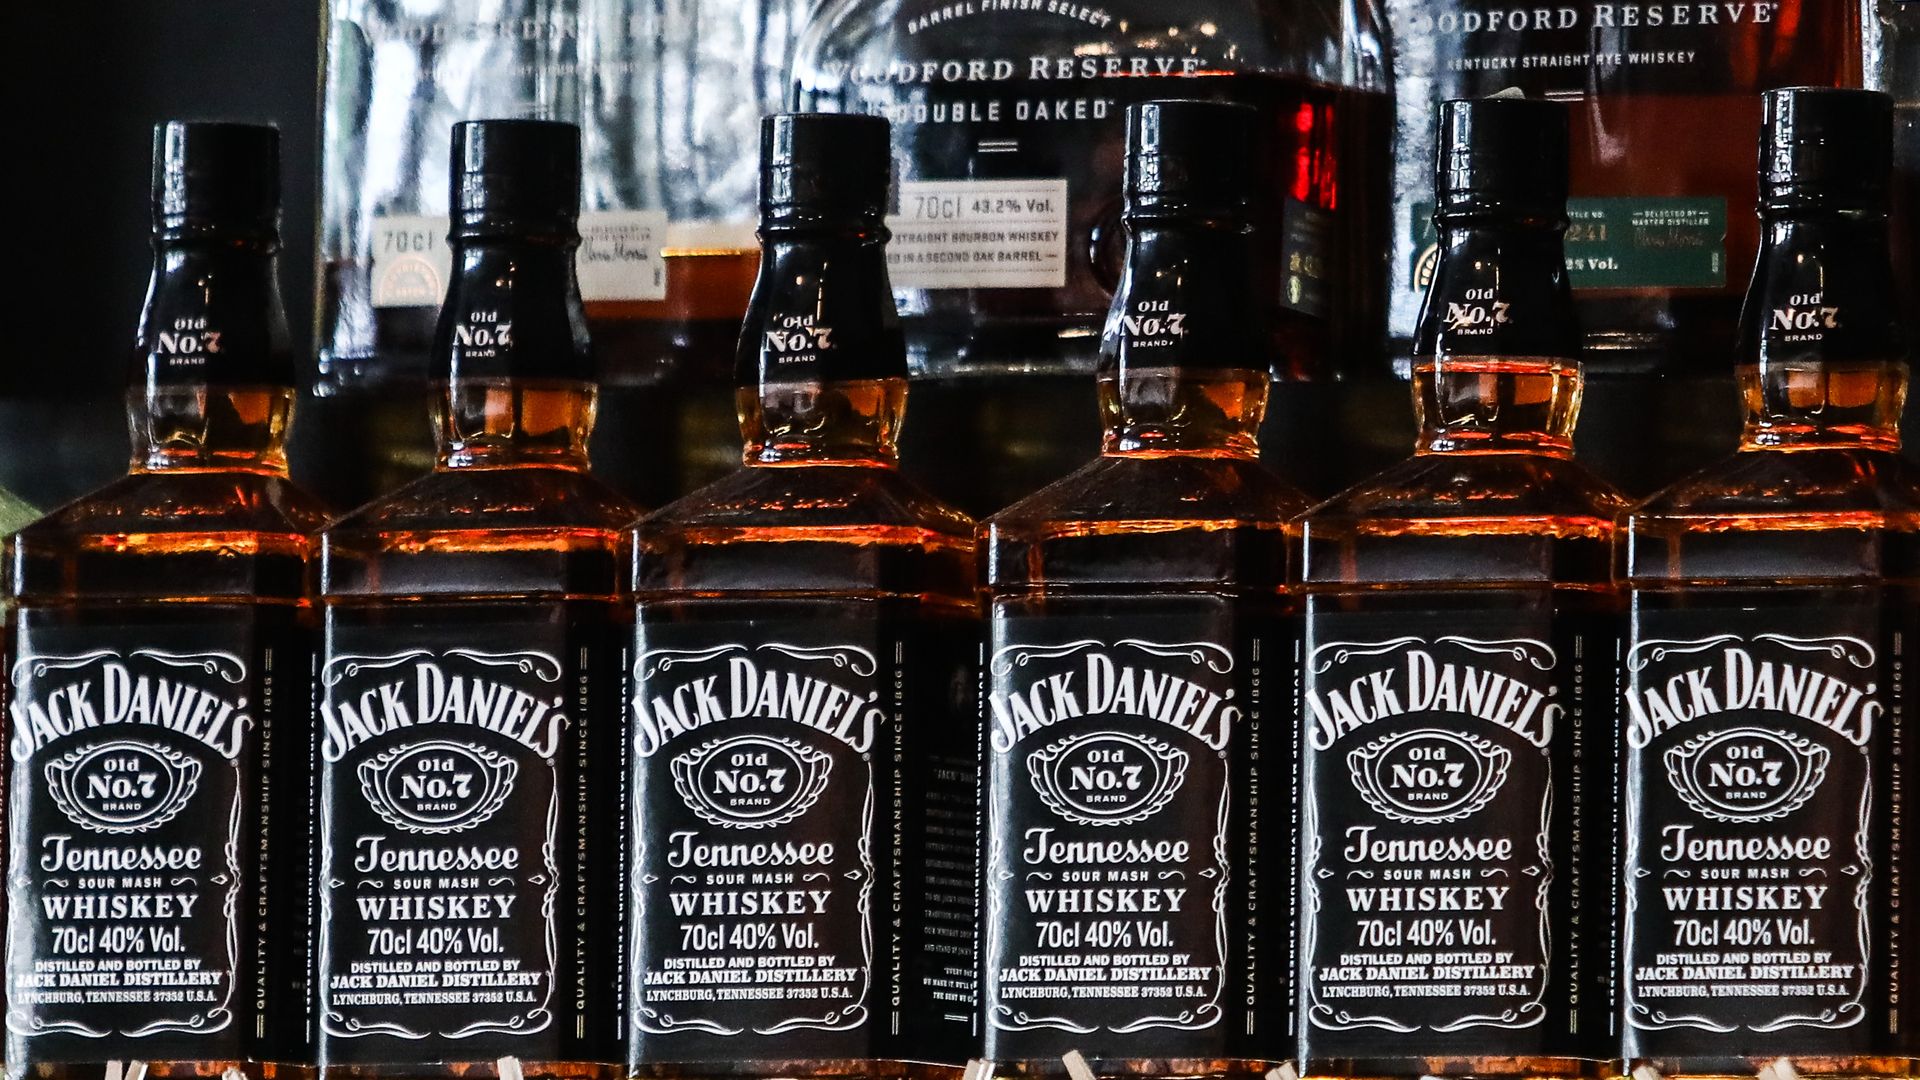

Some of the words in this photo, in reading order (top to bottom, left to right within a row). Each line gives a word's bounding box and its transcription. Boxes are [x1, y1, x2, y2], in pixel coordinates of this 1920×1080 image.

[908, 2, 974, 35] BARREL
[1048, 1, 1112, 28] SELECT
[1593, 3, 1771, 27] RESERVE
[1029, 56, 1201, 80] RESERVE
[1522, 54, 1590, 69] STRAIGHT
[1596, 53, 1622, 65] RYE
[1628, 52, 1695, 65] WHISKEY
[914, 196, 961, 219] 70cl
[972, 200, 1021, 215] 43.2%
[1026, 199, 1054, 214] Vol.
[1644, 210, 1685, 218] SELECTED
[1632, 218, 1664, 226] MASTER
[384, 230, 432, 253] 70cl
[895, 233, 948, 243] STRAIGHT
[951, 232, 1005, 243] BOURBON
[1008, 231, 1058, 242] WHISKEY
[903, 253, 915, 263] IN
[926, 253, 970, 262] SECOND
[973, 252, 994, 262] OAK
[997, 251, 1041, 262] BARREL
[1587, 257, 1619, 270] Vol.
[1466, 288, 1493, 300] Old
[1790, 294, 1820, 306] Old
[471, 312, 497, 322] Old
[1138, 301, 1168, 312] Old
[1443, 301, 1510, 323] No.7
[175, 318, 207, 330] Old
[782, 314, 813, 328] Old
[1120, 313, 1186, 336] No.7
[1769, 307, 1838, 330] No.7
[157, 332, 221, 353] No.7
[453, 325, 512, 346] No.7
[765, 327, 832, 352] No.7
[895, 670, 904, 706] 1866
[1625, 666, 1721, 749] JACK
[1724, 648, 1886, 746] DANIEL'S
[632, 675, 726, 757] JACK
[729, 657, 887, 753] DANIEL'S
[989, 670, 1082, 753] JACK
[1086, 654, 1244, 750] DANIEL'S
[1309, 668, 1403, 751] JACK
[1407, 650, 1567, 747] DANIEL'S
[9, 682, 99, 762] JACK
[102, 664, 255, 758] DANIEL'S
[320, 680, 413, 762] JACK
[416, 663, 572, 758] DANIEL'S
[893, 712, 903, 763] SINCE
[731, 753, 768, 767] Old
[1087, 749, 1124, 763] Old
[1409, 747, 1446, 761] Old
[1726, 745, 1764, 759] Old
[104, 758, 139, 772] Old
[418, 758, 454, 772] Old
[1391, 763, 1465, 788] No.7
[1708, 761, 1783, 787] No.7
[86, 774, 157, 799] No.7
[400, 774, 473, 799] No.7
[713, 769, 787, 794] No.7
[1070, 765, 1143, 791] No.7
[730, 798, 770, 806] BRAND
[1086, 795, 1126, 803] BRAND
[1408, 793, 1448, 801] BRAND
[1725, 791, 1766, 799] BRAND
[102, 803, 141, 811] BRAND
[417, 803, 456, 811] BRAND
[667, 831, 834, 867] Tennessee
[892, 768, 902, 913] CRAFTSMANSHIP
[1023, 828, 1189, 865] Tennessee
[1344, 826, 1512, 863] Tennessee
[1660, 825, 1831, 862] Tennessee
[40, 836, 201, 871] Tennessee
[354, 836, 519, 872] Tennessee
[78, 878, 115, 888] SOUR
[122, 878, 162, 888] MASH
[394, 879, 431, 889] SOUR
[438, 878, 479, 888] MASH
[707, 874, 745, 884] SOUR
[752, 873, 793, 884] MASH
[1063, 872, 1100, 882] SOUR
[1108, 871, 1149, 881] MASH
[1384, 870, 1422, 880] SOUR
[1430, 869, 1471, 879] MASH
[1701, 869, 1740, 879] SOUR
[1747, 868, 1789, 878] MASH
[41, 893, 199, 920] WHISKEY
[356, 894, 517, 921] WHISKEY
[669, 889, 832, 916] WHISKEY
[1024, 887, 1187, 914] WHISKEY
[1345, 885, 1510, 912] WHISKEY
[1662, 884, 1828, 911] WHISKEY
[51, 928, 94, 954] 70cl
[99, 927, 145, 953] 40%
[150, 927, 185, 953] Vol.
[367, 929, 411, 955] 70cl
[416, 928, 463, 954] 40%
[468, 928, 503, 953] Vol.
[680, 924, 724, 950] 70cl
[730, 923, 777, 950] 40%
[782, 923, 818, 949] Vol.
[1036, 921, 1079, 948] 70cl
[1085, 921, 1132, 948] 40%
[1137, 921, 1173, 947] Vol.
[1357, 920, 1401, 947] 70cl
[1407, 919, 1454, 946] 40%
[1459, 920, 1496, 946] Vol.
[1673, 919, 1718, 946] 70cl
[1724, 919, 1772, 946] 40%
[1777, 919, 1814, 945] Vol.
[892, 932, 900, 1006] QUALITY
[1019, 956, 1081, 966] DISTILLED
[1084, 956, 1111, 966] AND
[1113, 955, 1170, 966] BOTTLED
[1172, 955, 1190, 965] BY
[999, 967, 1041, 982] JACK
[1044, 968, 1107, 982] DANIEL
[1111, 967, 1212, 982] DISTILLERY
[1001, 987, 1071, 999] LYNCHBURG,
[1072, 987, 1138, 998] TENNESSEE
[1141, 987, 1173, 998] 37352
[1175, 986, 1206, 998] U.S.A.
